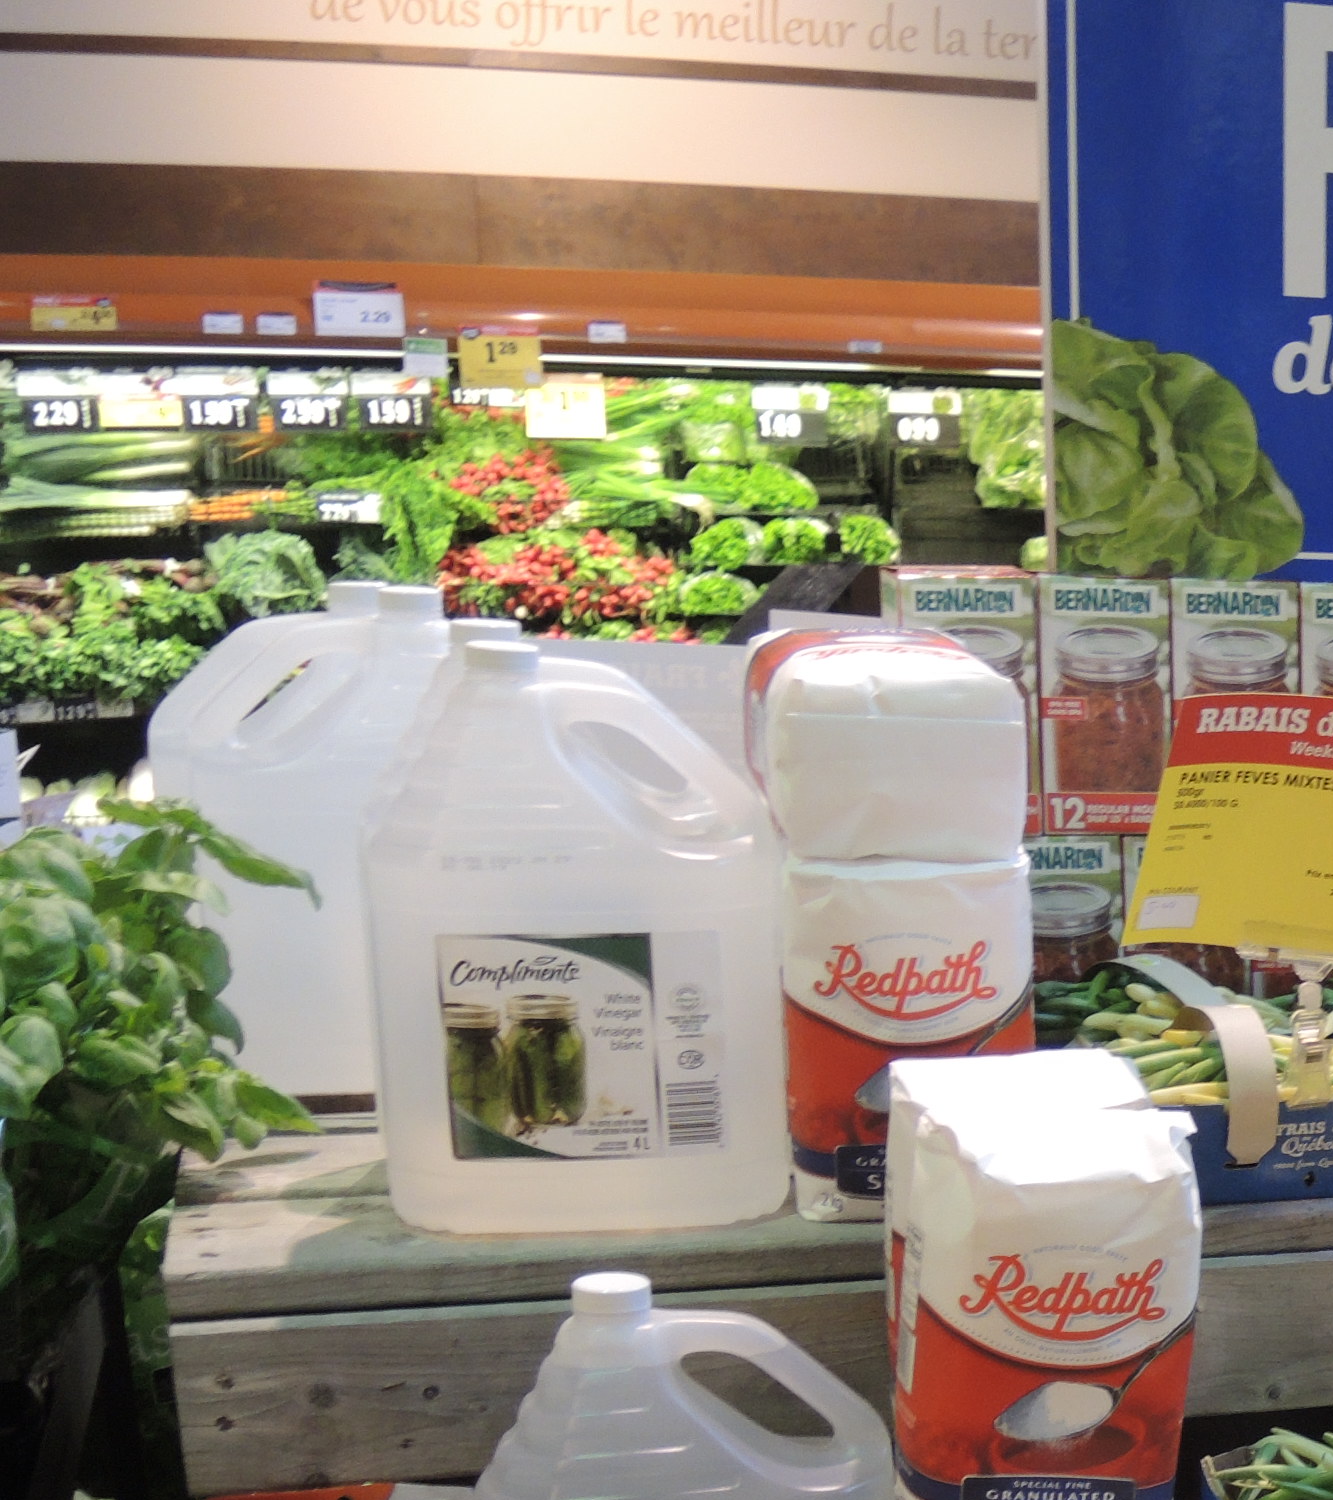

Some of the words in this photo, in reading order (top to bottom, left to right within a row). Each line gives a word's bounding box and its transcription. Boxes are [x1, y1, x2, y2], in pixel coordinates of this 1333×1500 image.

[380, 0, 480, 24] vous
[495, 0, 602, 47] offrir
[625, 0, 660, 36] le
[675, 0, 848, 48] meilleur
[869, 9, 918, 54] de
[934, 15, 971, 57] la
[1196, 706, 1311, 735] RABAIS
[1179, 771, 1232, 786] PANIER
[1234, 771, 1279, 787] FEVES
[1050, 797, 1086, 830] 12
[450, 957, 581, 990] Compliments
[813, 940, 996, 1021] Redpath
[609, 1038, 644, 1051] blanc
[959, 1254, 1166, 1341] Redpath
